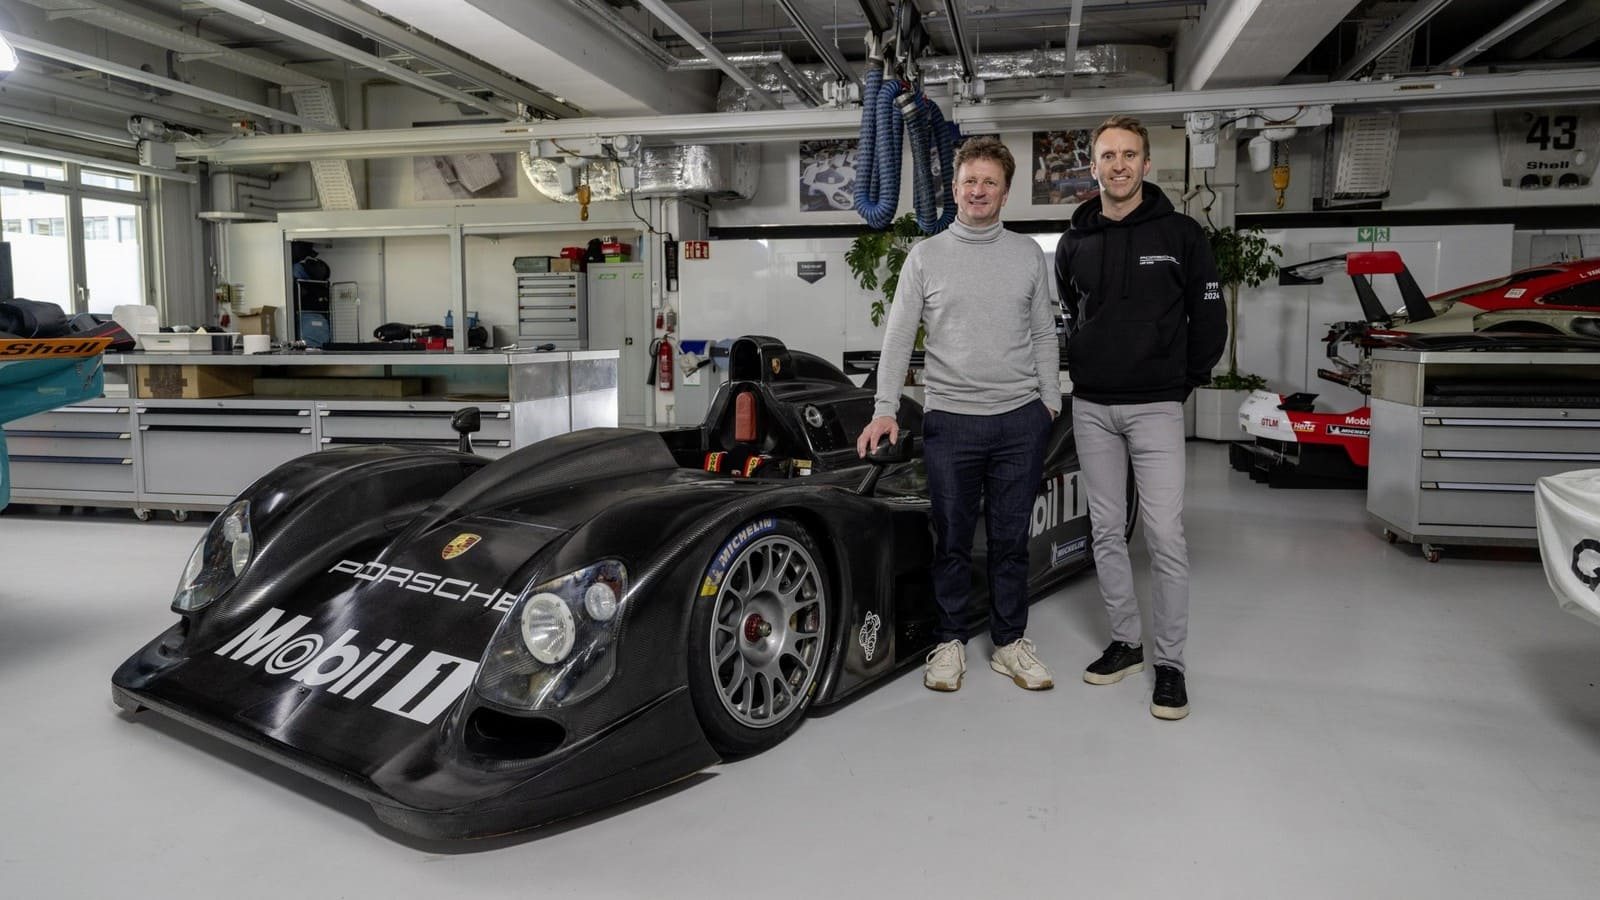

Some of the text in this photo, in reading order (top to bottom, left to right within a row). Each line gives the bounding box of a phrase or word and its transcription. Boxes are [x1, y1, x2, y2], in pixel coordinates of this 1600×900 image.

[1526, 115, 1577, 150] 43
[1526, 160, 1569, 169] Shell
[1203, 291, 1220, 300] 2024
[0, 342, 99, 355] Shell
[1262, 417, 1279, 427] GTLM
[1293, 421, 1316, 432] Hertz
[719, 518, 772, 567] MICHELIN
[1057, 540, 1086, 558] MICHELIN
[328, 559, 516, 613] PORSCHE
[213, 607, 414, 699] Mobil
